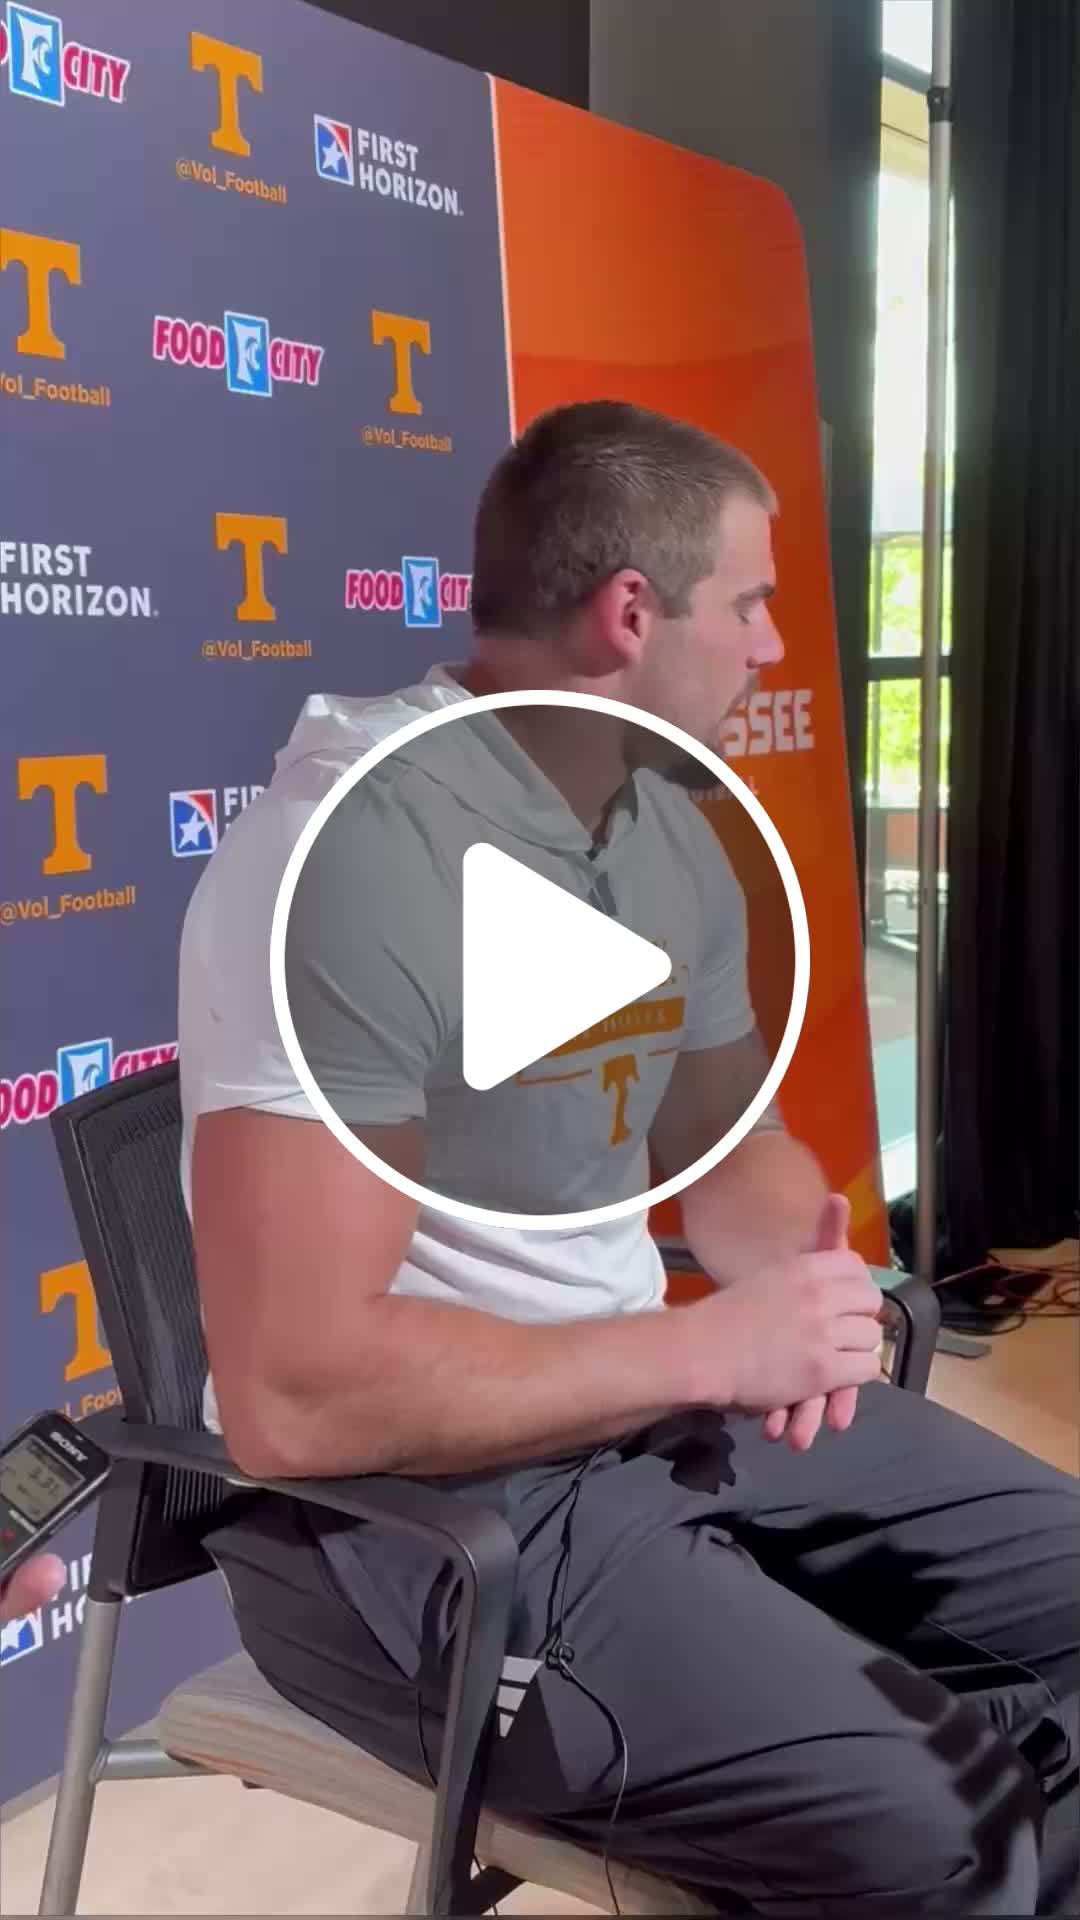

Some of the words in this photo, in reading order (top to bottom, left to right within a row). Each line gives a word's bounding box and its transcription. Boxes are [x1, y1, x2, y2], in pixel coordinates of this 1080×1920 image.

[63, 41, 131, 104] CITY
[357, 127, 418, 172] FIRST
[175, 158, 288, 205] @Vol_Football
[153, 315, 226, 369] FOOD
[270, 337, 325, 386] CITY
[0, 371, 112, 409] ol_Football
[361, 425, 453, 453] @Vol_Football
[0, 541, 92, 577] FIRST
[345, 568, 404, 611] FOOD
[438, 573, 474, 612] CIT
[202, 639, 313, 662] @Vol_Football
[0, 885, 136, 926] @Vol_Football
[49, 1431, 89, 1462] SONY
